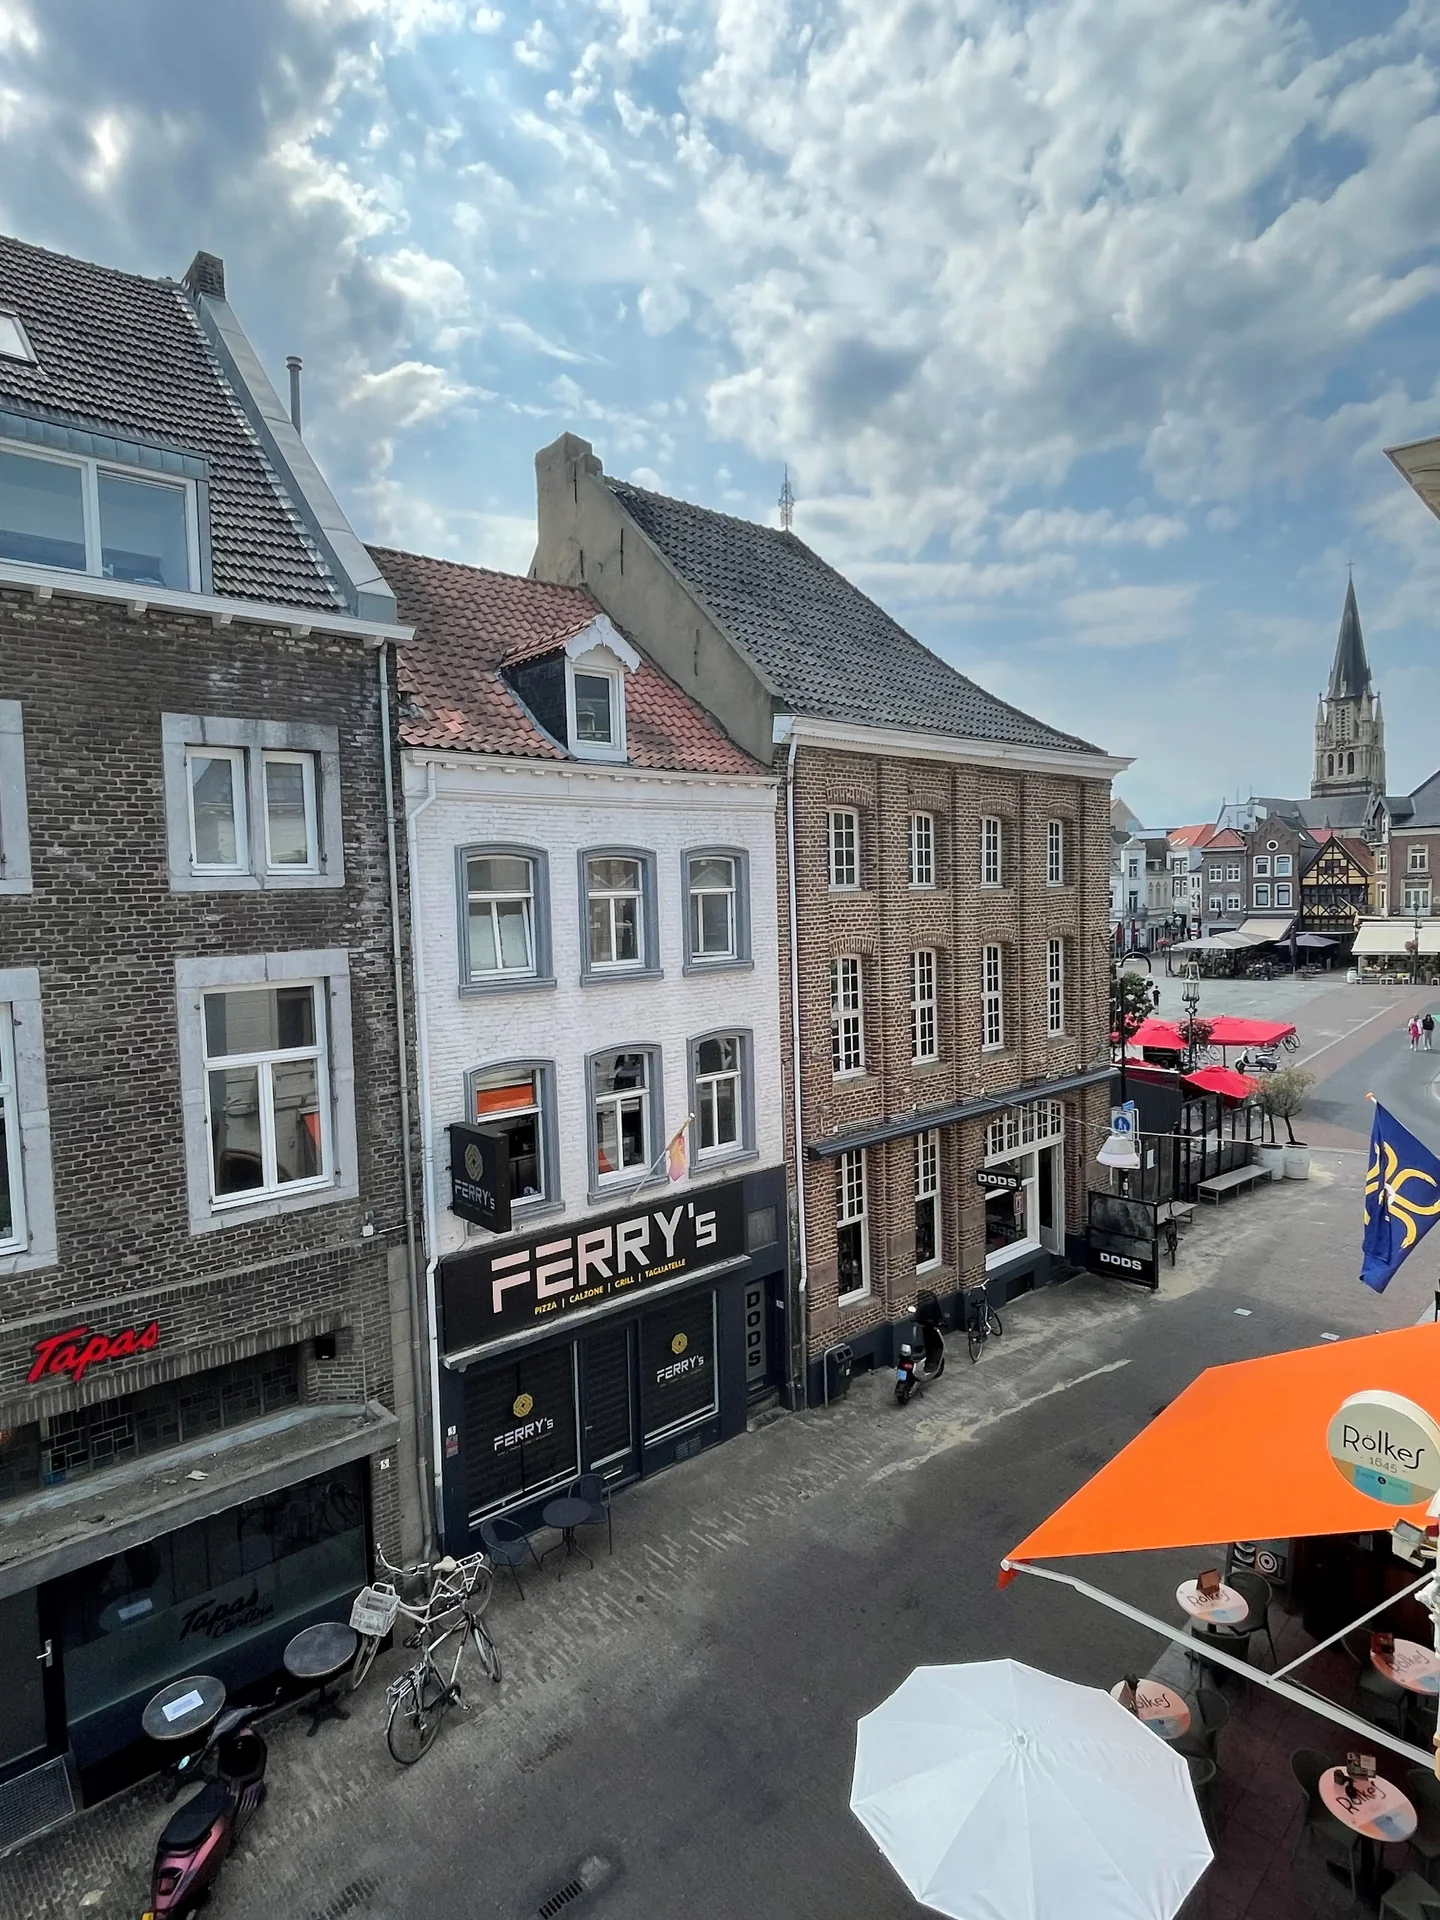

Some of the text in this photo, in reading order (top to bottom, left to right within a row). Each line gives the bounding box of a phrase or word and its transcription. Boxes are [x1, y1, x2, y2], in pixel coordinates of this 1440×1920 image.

[978, 1173, 1017, 1187] DODS
[491, 1202, 717, 1314] FERRY's
[1100, 1252, 1142, 1270] DODS
[534, 1258, 686, 1315] PIZZA CALZONE GRILL TAGLIATELLE
[26, 1320, 159, 1384] Tapas
[746, 1291, 761, 1367] DODS
[1369, 1456, 1398, 1474] 1645
[179, 1587, 259, 1641] Tapas
